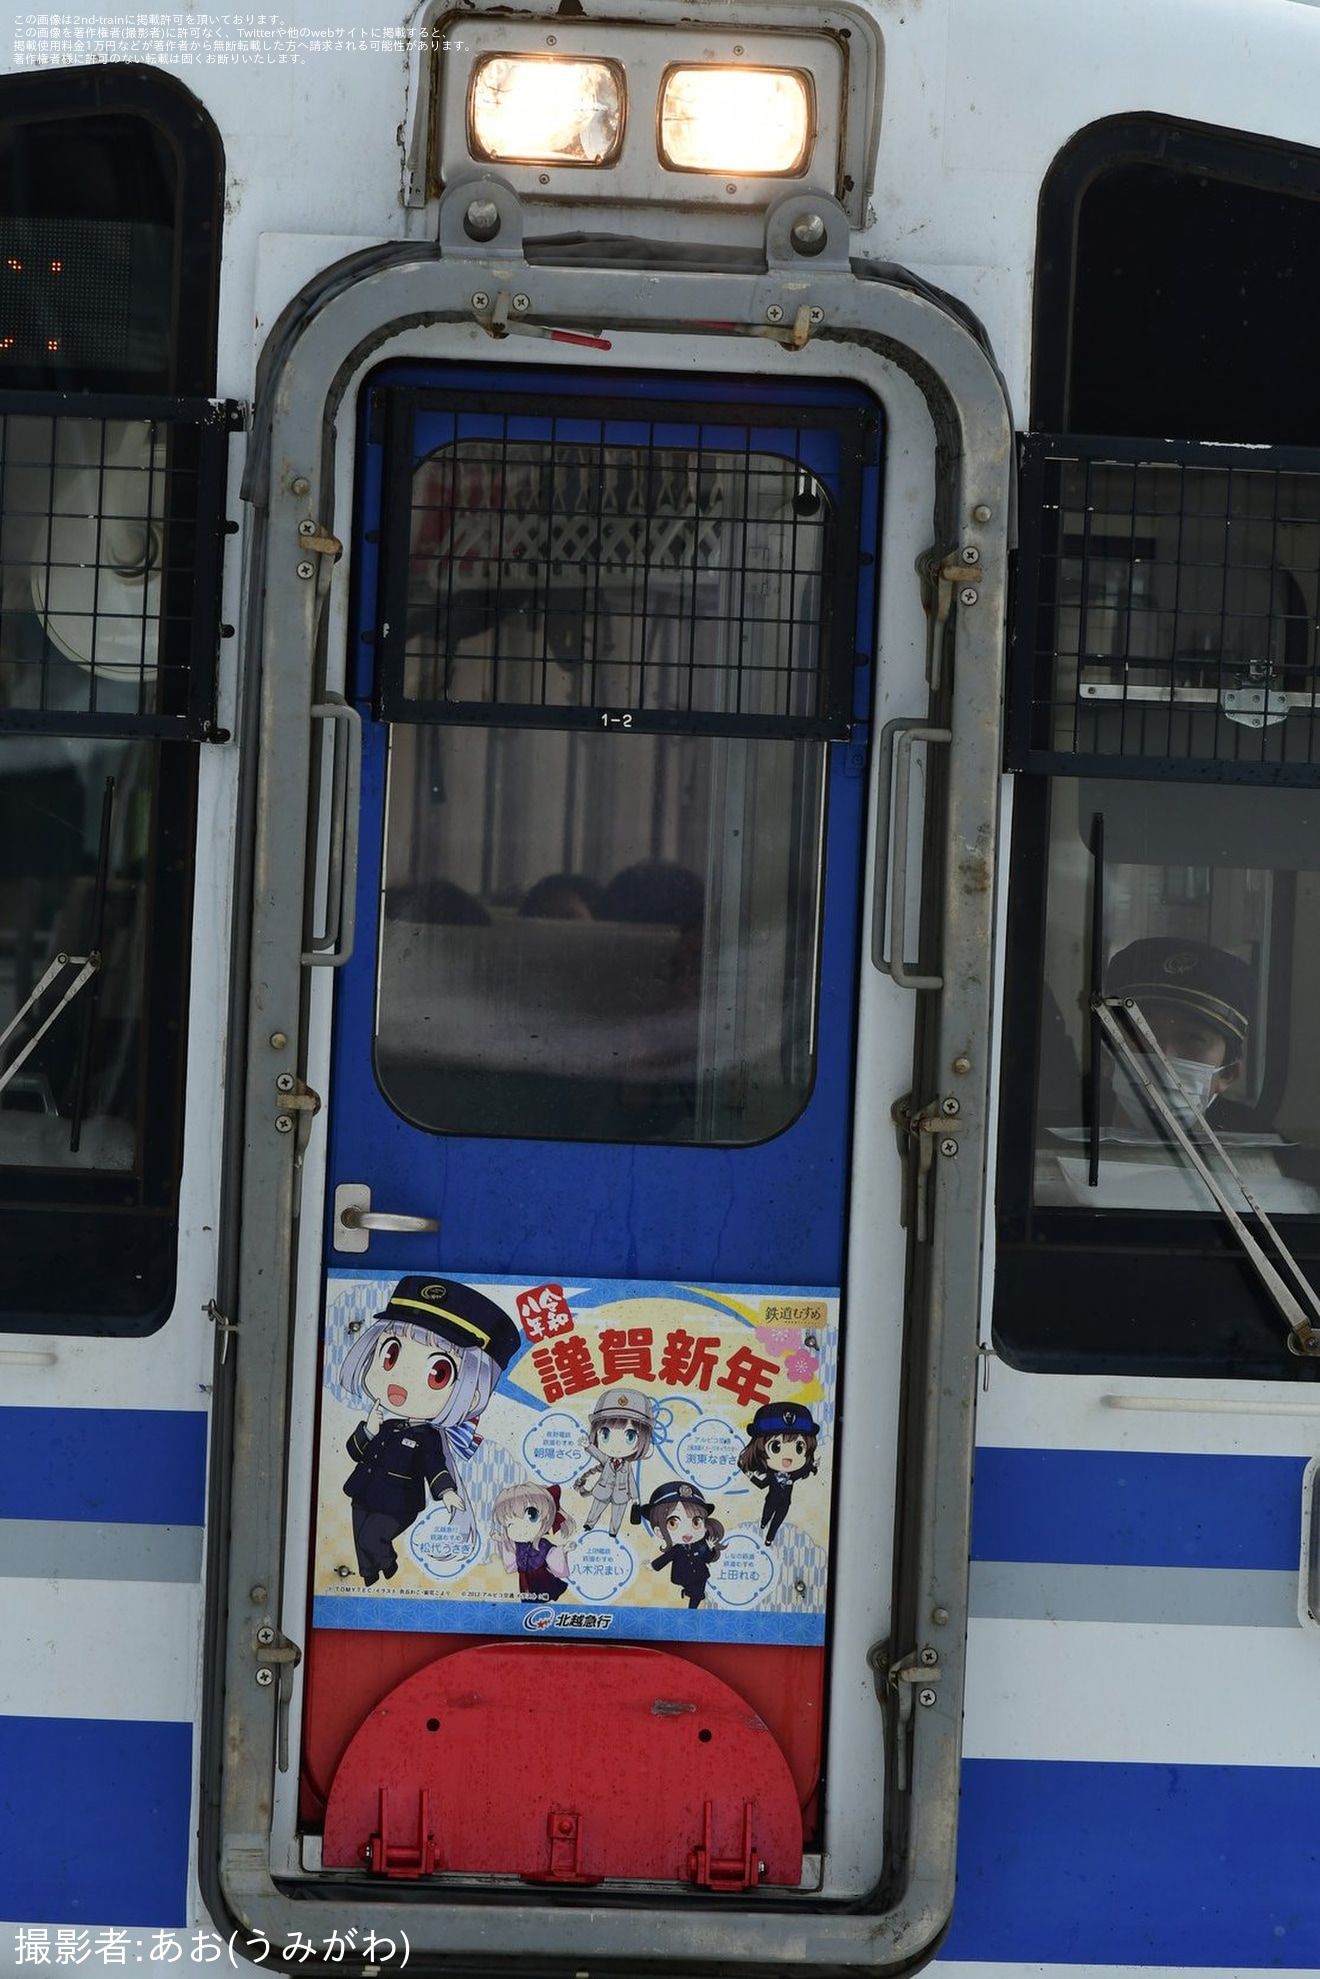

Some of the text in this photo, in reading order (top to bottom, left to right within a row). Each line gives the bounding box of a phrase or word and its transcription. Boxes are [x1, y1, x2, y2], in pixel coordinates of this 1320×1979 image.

[601, 713, 632, 728] 1-2
[764, 1306, 821, 1324] 鉄道むすめ
[531, 1327, 781, 1407] 謹賀新年
[533, 1447, 582, 1460] 朝陽さくら
[420, 1542, 471, 1554] 松代うさぎ
[571, 1563, 625, 1576] 八木沢まい
[717, 1569, 761, 1581] 上田れむ
[555, 1613, 613, 1629] 北越急行
